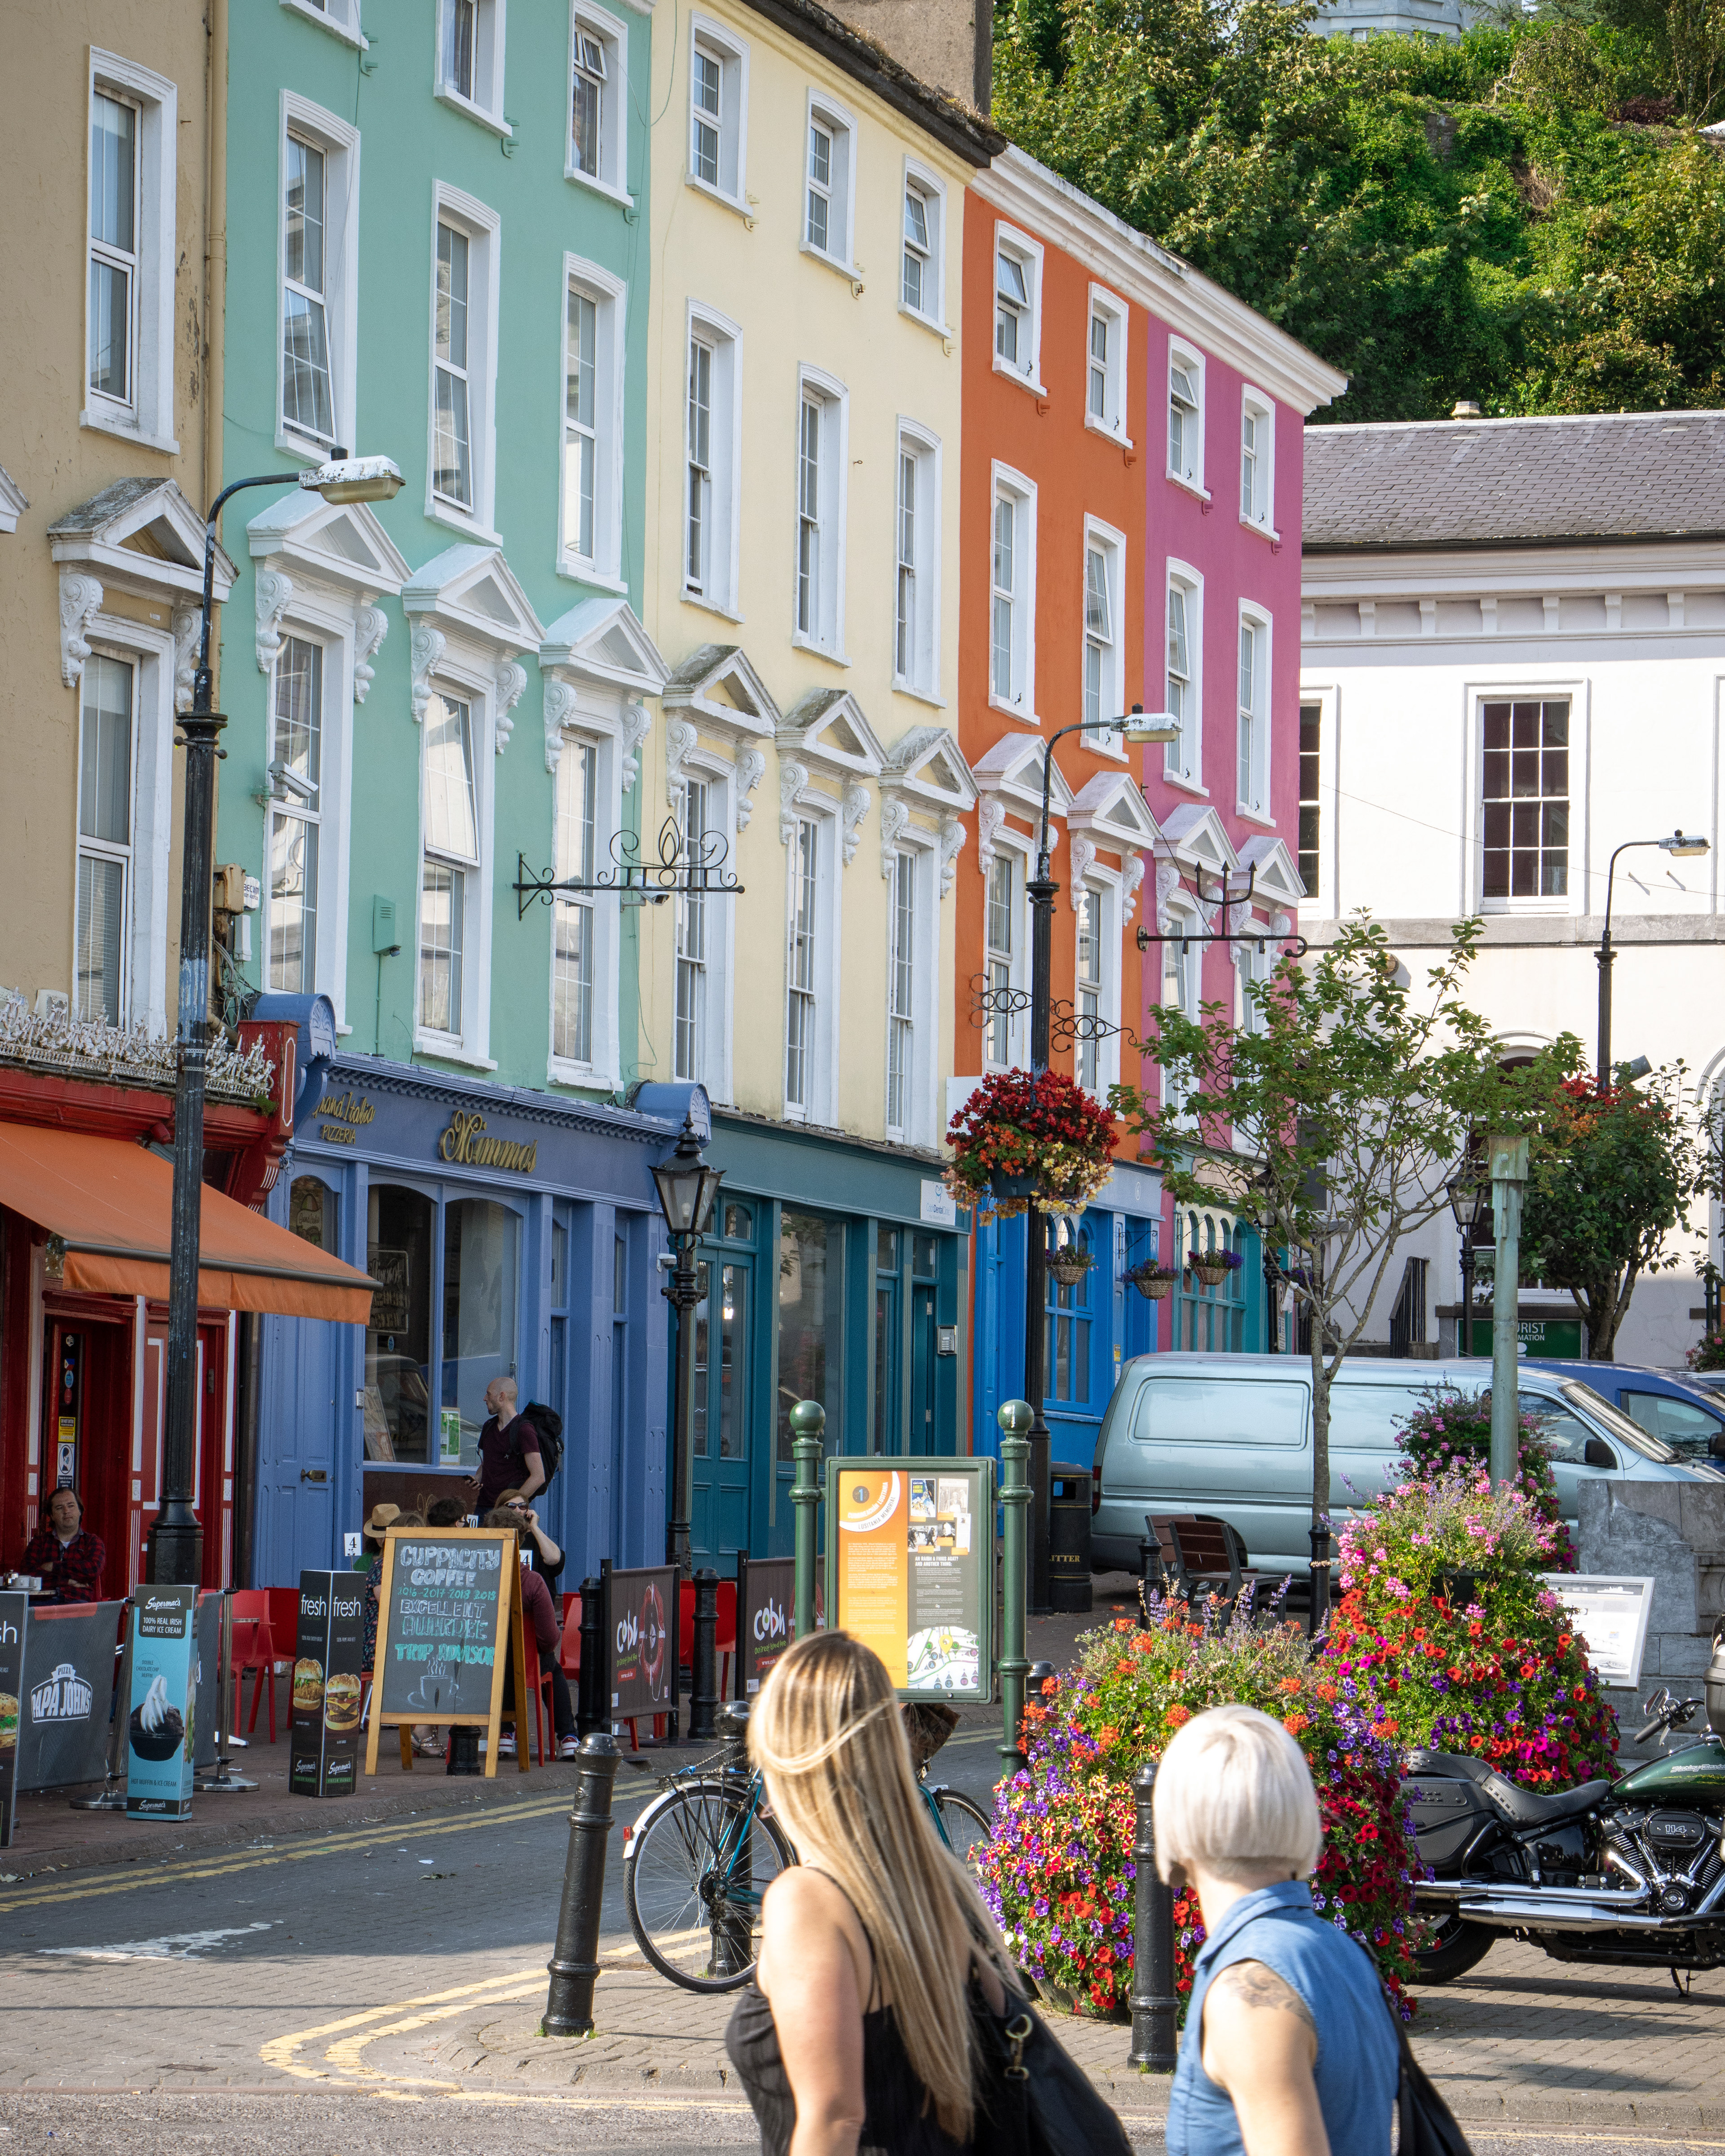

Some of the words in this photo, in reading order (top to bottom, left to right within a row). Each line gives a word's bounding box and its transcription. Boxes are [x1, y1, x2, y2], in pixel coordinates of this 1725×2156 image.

[312, 1094, 345, 1118] rand
[343, 1091, 376, 1124] Italia
[322, 1124, 356, 1144] PIZZERIA
[1517, 1322, 1546, 1334] RIST
[877, 1482, 888, 1505] LUSITANIA
[858, 1517, 881, 1529] LUSITANIA
[880, 1497, 896, 1519] MEMORIAL
[349, 1537, 357, 1548] 4
[400, 1546, 500, 1570] CUPPACITY
[411, 1568, 477, 1587] COFFEE
[145, 1596, 181, 1611] Supermac's
[301, 1594, 327, 1616] fresh
[333, 1596, 361, 1617] fresh
[400, 1599, 486, 1618] EXCELLENT
[754, 1597, 786, 1641] cobh
[395, 1644, 433, 1661] TRIP
[438, 1644, 495, 1666] ADVISOR
[58, 1667, 71, 1675] PIZZA
[32, 1683, 59, 1718] PAPA
[60, 1681, 91, 1716] JOHNS
[296, 1760, 315, 1773] Supermac's
[328, 1761, 351, 1775] Supermac's
[139, 1799, 166, 1811] Supermac's
[1665, 1824, 1687, 1833] 114
